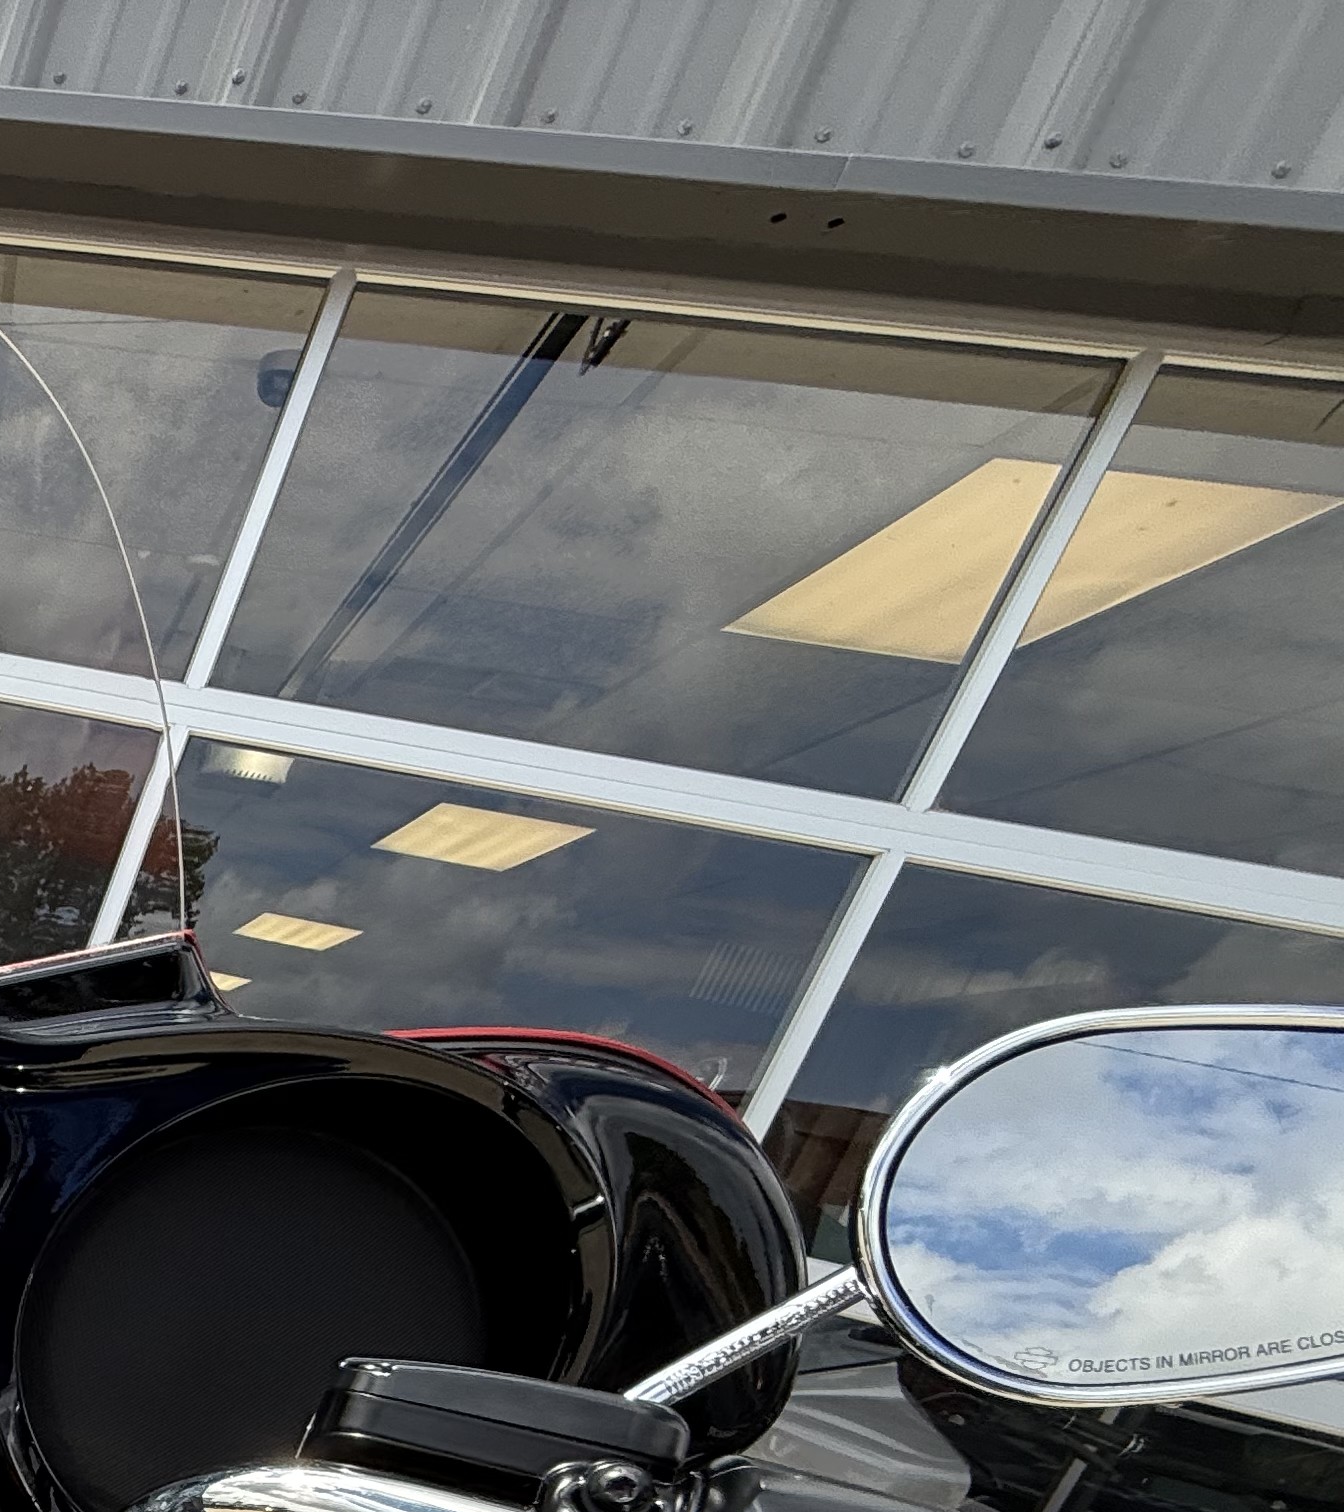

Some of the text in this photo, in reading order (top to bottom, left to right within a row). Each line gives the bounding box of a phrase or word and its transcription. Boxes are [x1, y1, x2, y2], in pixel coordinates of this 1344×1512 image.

[1068, 1330, 1344, 1373] OBJECTS IN MIRROR ARE CLOS
